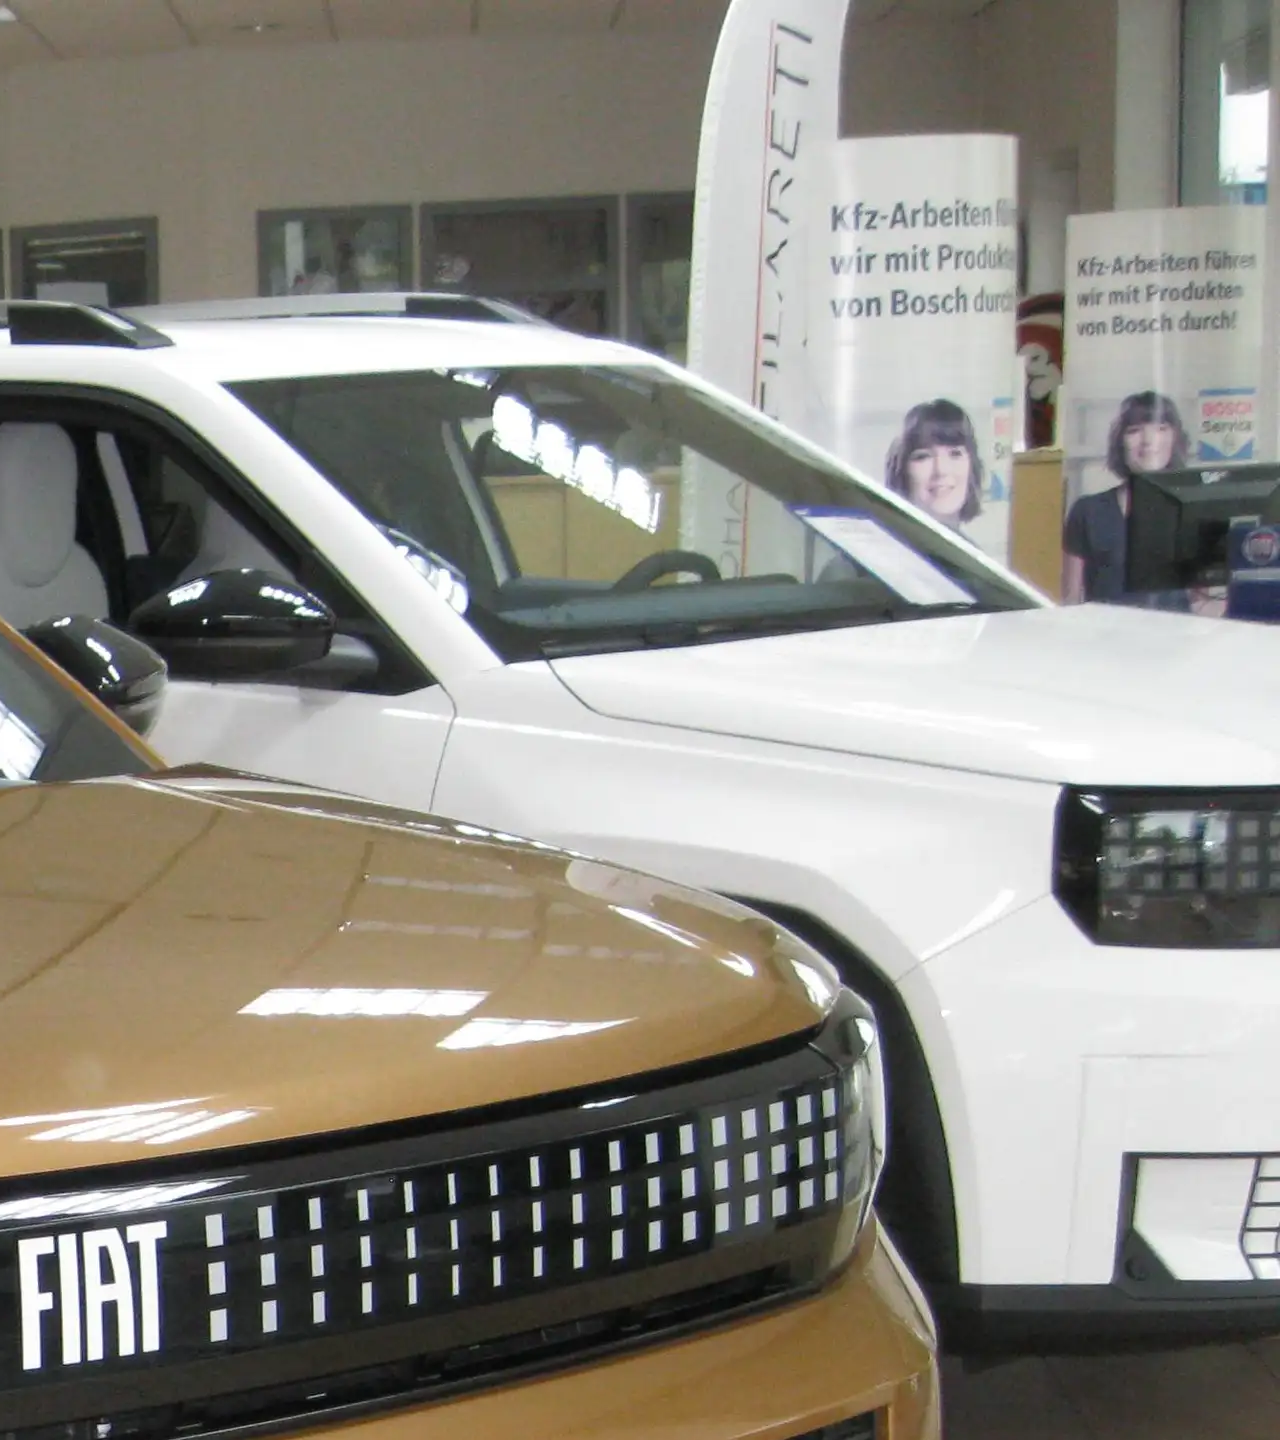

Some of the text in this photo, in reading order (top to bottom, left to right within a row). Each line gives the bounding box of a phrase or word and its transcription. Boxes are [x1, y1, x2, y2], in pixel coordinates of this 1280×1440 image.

[830, 200, 992, 232] Kfz-Arbeiten
[830, 246, 877, 276] wir
[885, 244, 930, 273] mit
[1077, 253, 1199, 277] Kfz-Arbeiten
[829, 296, 882, 319] von
[890, 285, 968, 317] Bosch
[1077, 281, 1245, 309] wir mit Produkten
[1076, 309, 1238, 337] von Bosch durch!
[17, 1220, 168, 1371] FIAT
